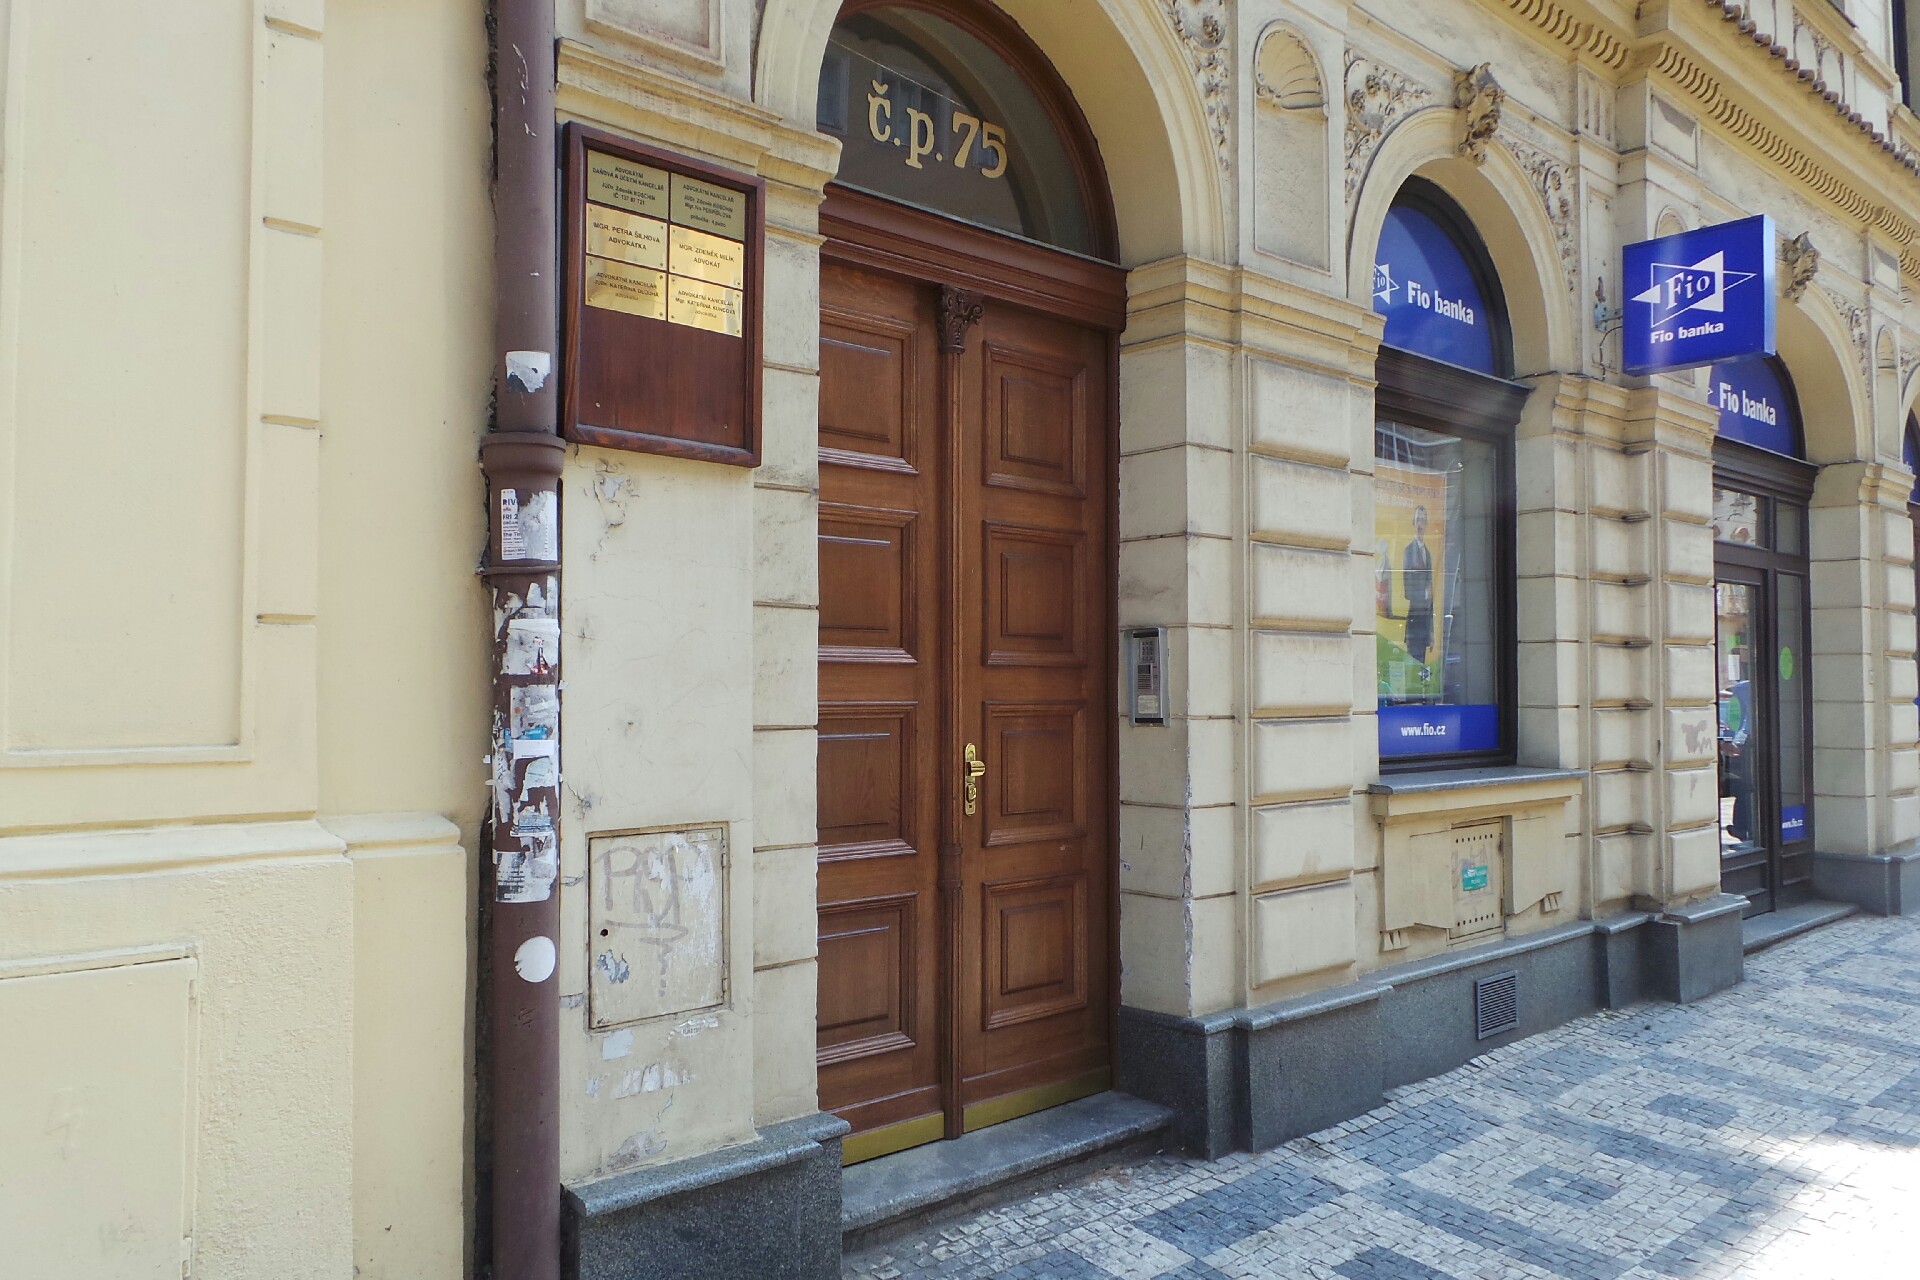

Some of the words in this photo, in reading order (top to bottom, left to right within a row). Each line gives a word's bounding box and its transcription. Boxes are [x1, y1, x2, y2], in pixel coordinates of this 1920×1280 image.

[867, 79, 943, 169] č.p.
[952, 111, 1008, 179] 75
[593, 222, 610, 232] MGR.
[612, 226, 633, 237] PETRA
[1407, 280, 1431, 309] Fio
[1434, 290, 1474, 325] banka
[1666, 272, 1710, 310] Fio
[1650, 331, 1673, 344] Fio
[1678, 321, 1724, 339] banka
[1719, 382, 1739, 414] Fio
[1742, 390, 1776, 426] banka
[1401, 722, 1446, 737] www.fio.cz
